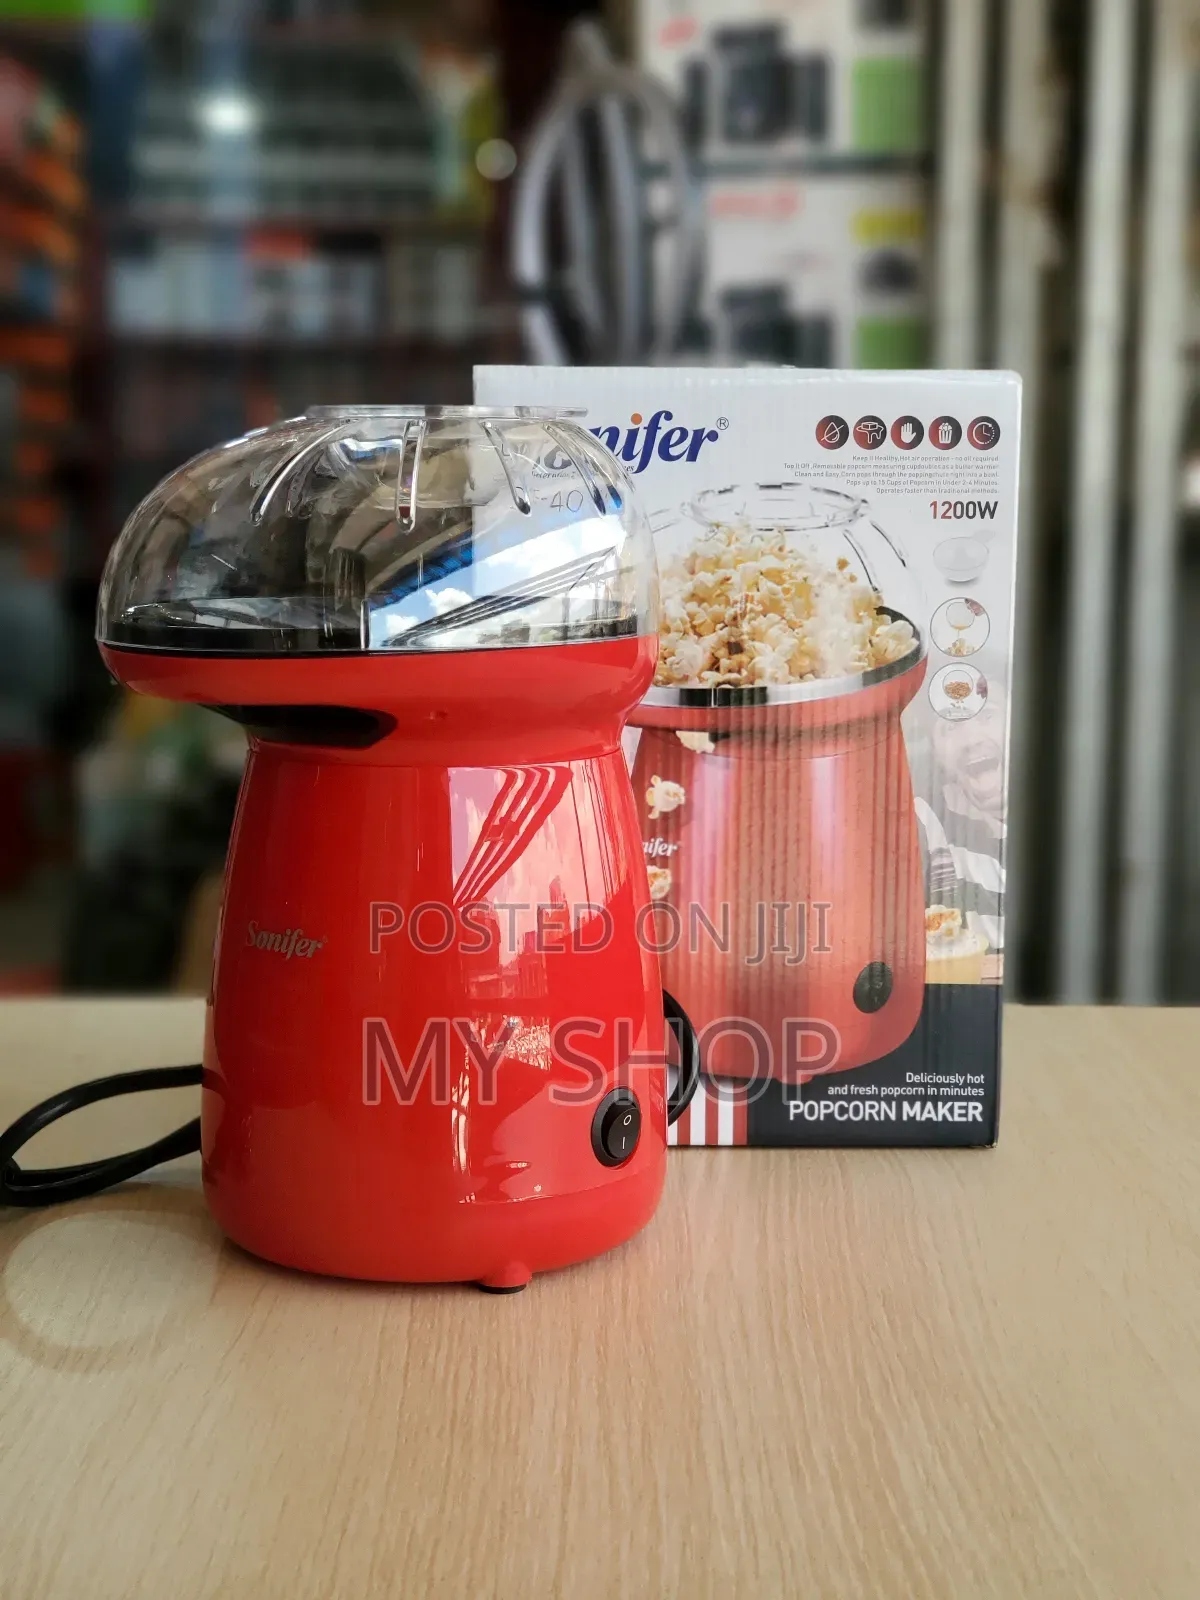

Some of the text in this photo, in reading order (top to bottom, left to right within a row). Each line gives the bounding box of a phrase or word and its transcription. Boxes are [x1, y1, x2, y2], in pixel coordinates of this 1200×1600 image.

[930, 500, 999, 520] 1200W
[246, 920, 324, 961] Sonifer
[906, 1072, 985, 1086] Deliciously hot
[827, 1084, 985, 1098] and fresh popcorn in minutes
[789, 1100, 984, 1122] POPCORN MAKER
